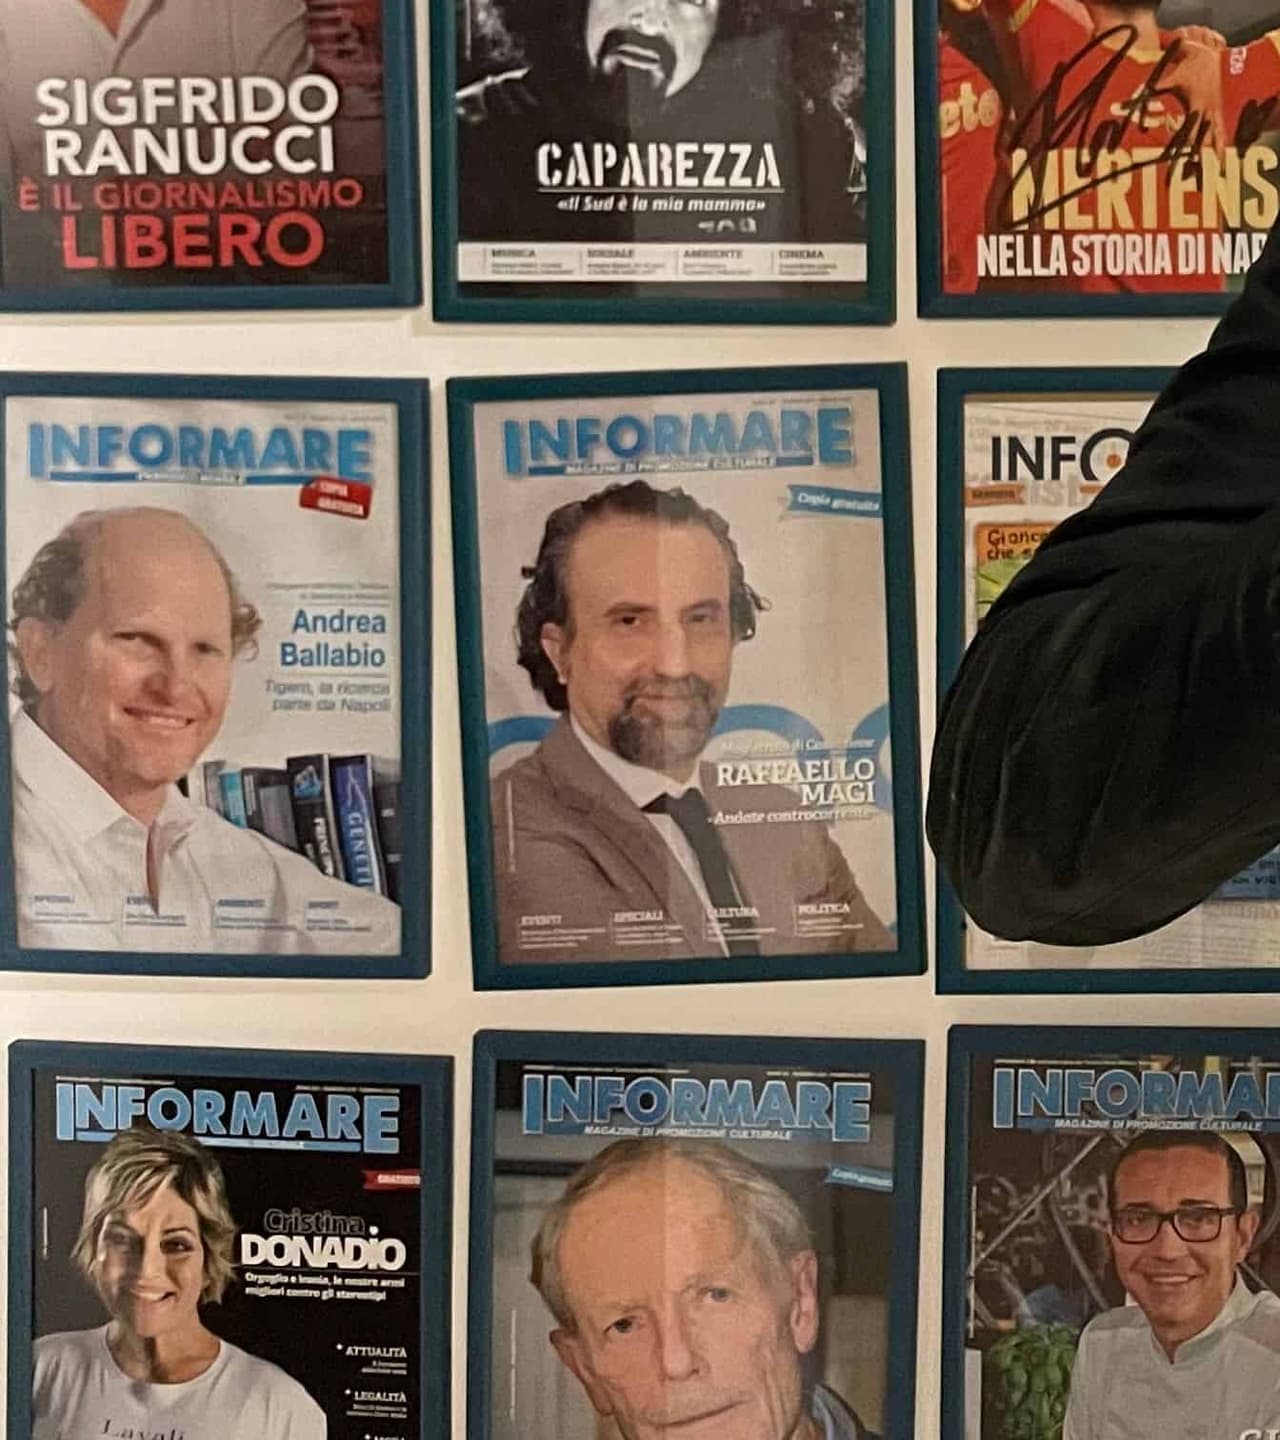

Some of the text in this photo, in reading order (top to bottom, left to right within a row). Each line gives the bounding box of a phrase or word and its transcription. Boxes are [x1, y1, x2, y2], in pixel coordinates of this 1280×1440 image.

[35, 75, 340, 128] SIGFRIDO
[43, 126, 336, 177] RANUCCI
[536, 141, 782, 189] CAPAREZZA
[17, 176, 364, 212] È IL GIORNALISMO
[1010, 145, 1280, 233] MERTENS
[61, 212, 326, 271] LIBERO
[976, 233, 1269, 278] NELLA STORIA DI NAP
[30, 420, 373, 481] INFORMARE
[504, 407, 856, 476] INFORMARE
[292, 609, 387, 635] Andrea
[280, 642, 386, 669] Ballabio
[715, 758, 875, 787] RAFFAELLO
[800, 781, 876, 806] MAGI
[56, 1082, 400, 1154] INFORMARE
[523, 1073, 871, 1142] INFORMARE
[264, 1207, 366, 1236] Cristina
[346, 1344, 408, 1359] ATTUALITÀ
[354, 1389, 408, 1403] LEGALITÀ
